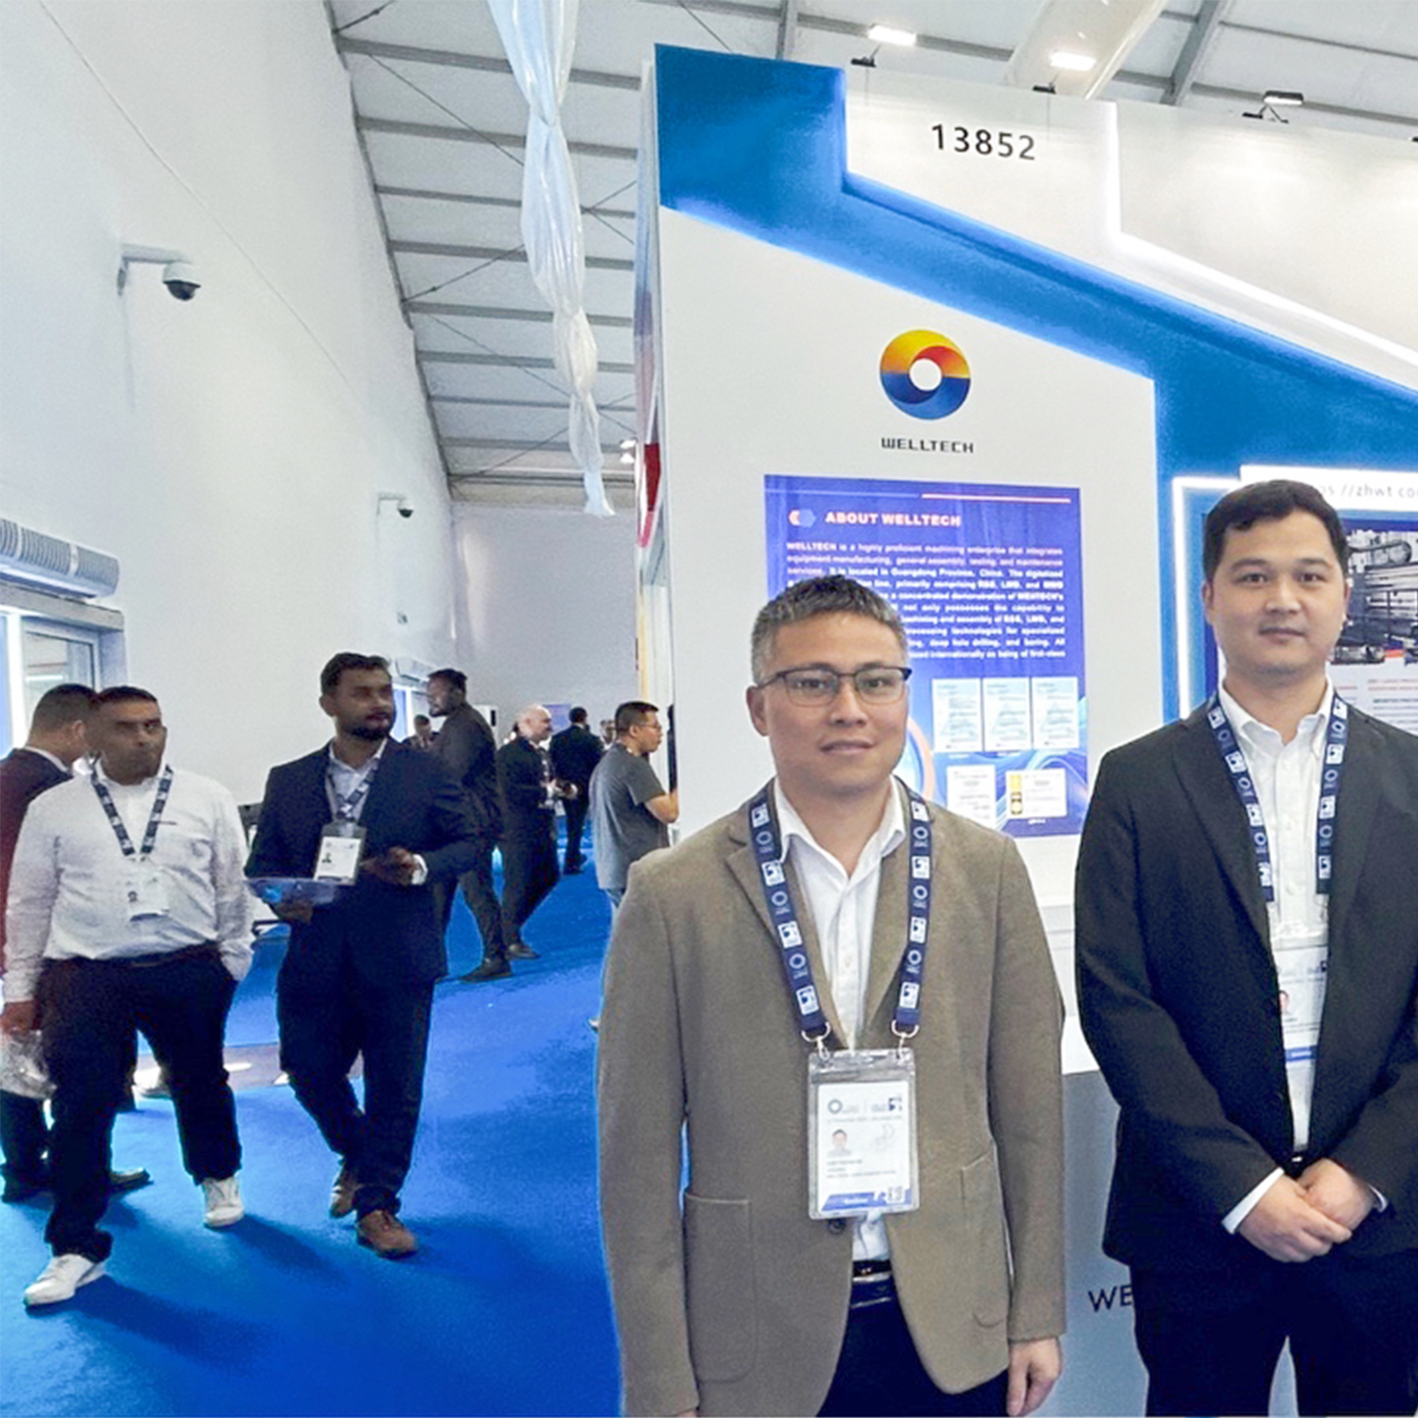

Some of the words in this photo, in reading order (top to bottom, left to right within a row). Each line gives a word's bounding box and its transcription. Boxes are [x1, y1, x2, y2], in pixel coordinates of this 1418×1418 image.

[932, 124, 1036, 161] 13852
[881, 437, 974, 454] WELLTECH
[825, 512, 879, 524] ABOUT
[881, 514, 961, 526] WELLTECH
